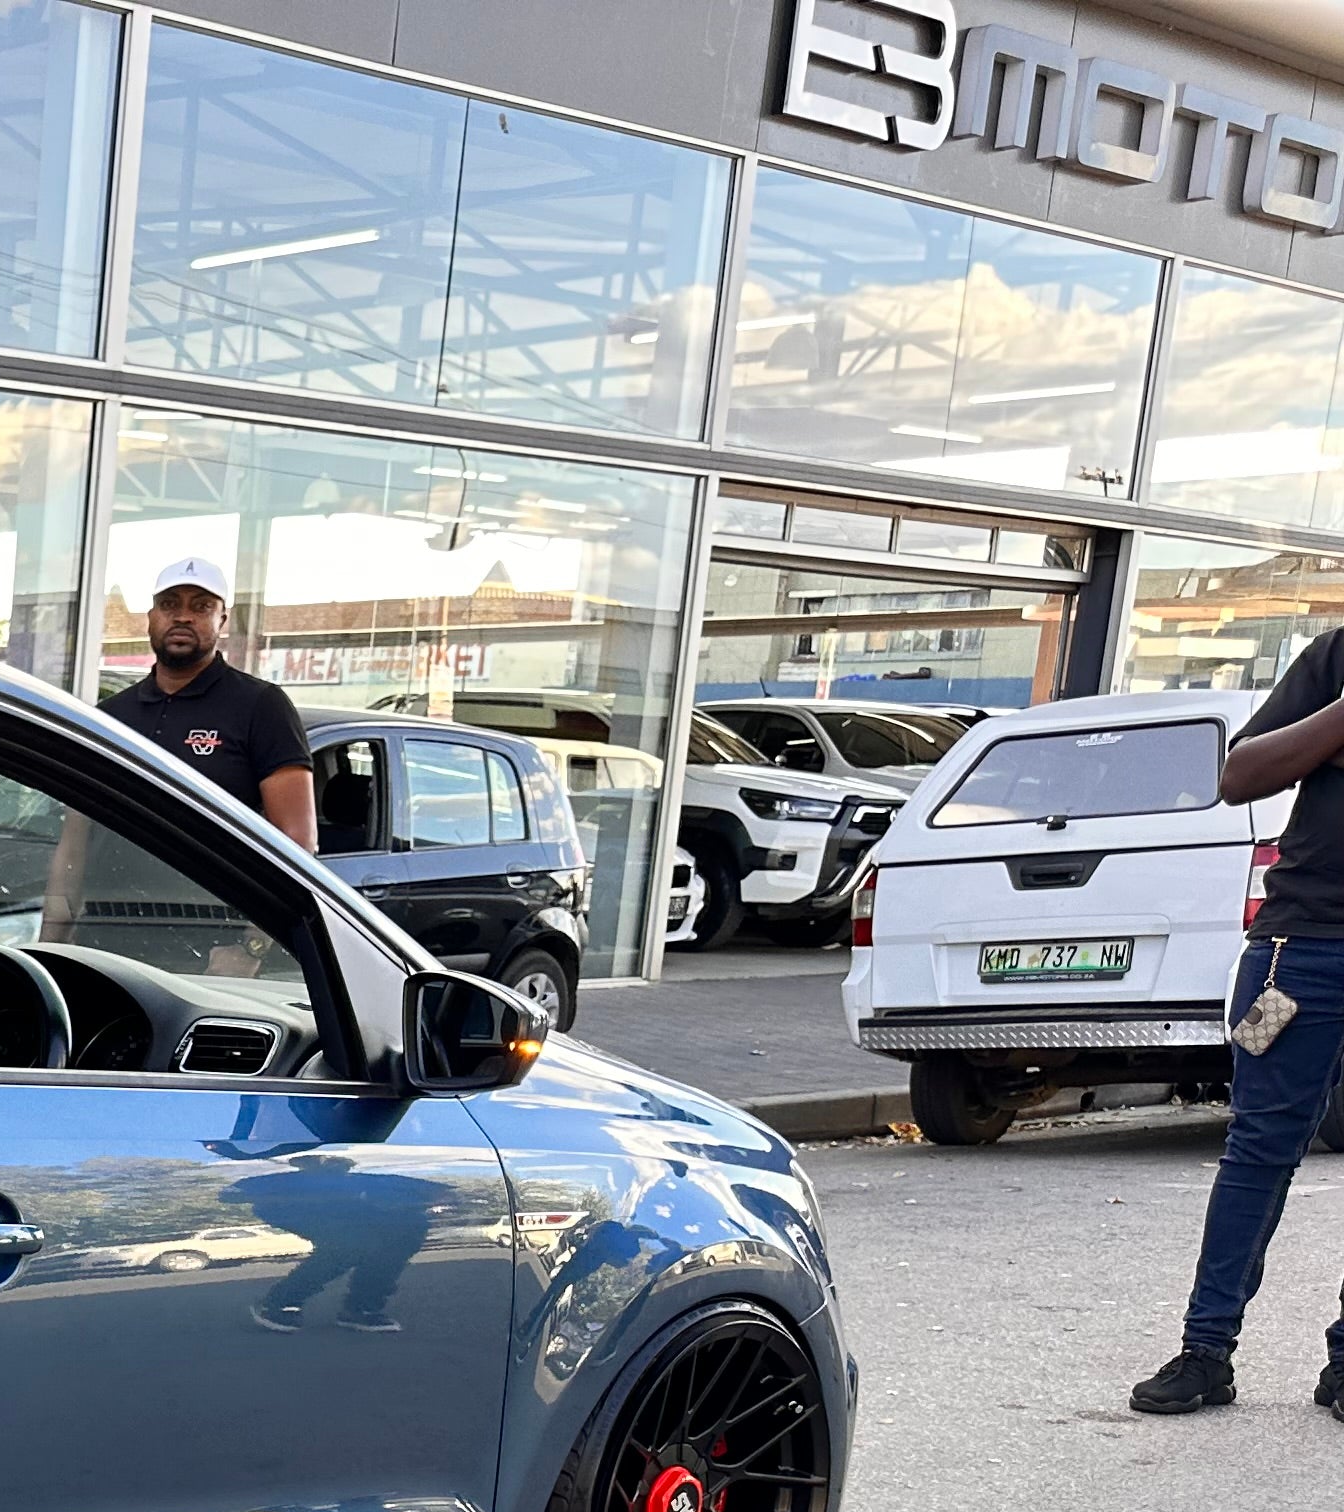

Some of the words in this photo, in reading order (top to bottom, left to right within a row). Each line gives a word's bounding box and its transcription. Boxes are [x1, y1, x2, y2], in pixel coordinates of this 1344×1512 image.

[983, 947, 1021, 970] KMD
[1040, 945, 1078, 969] 737
[1099, 943, 1127, 967] NW
